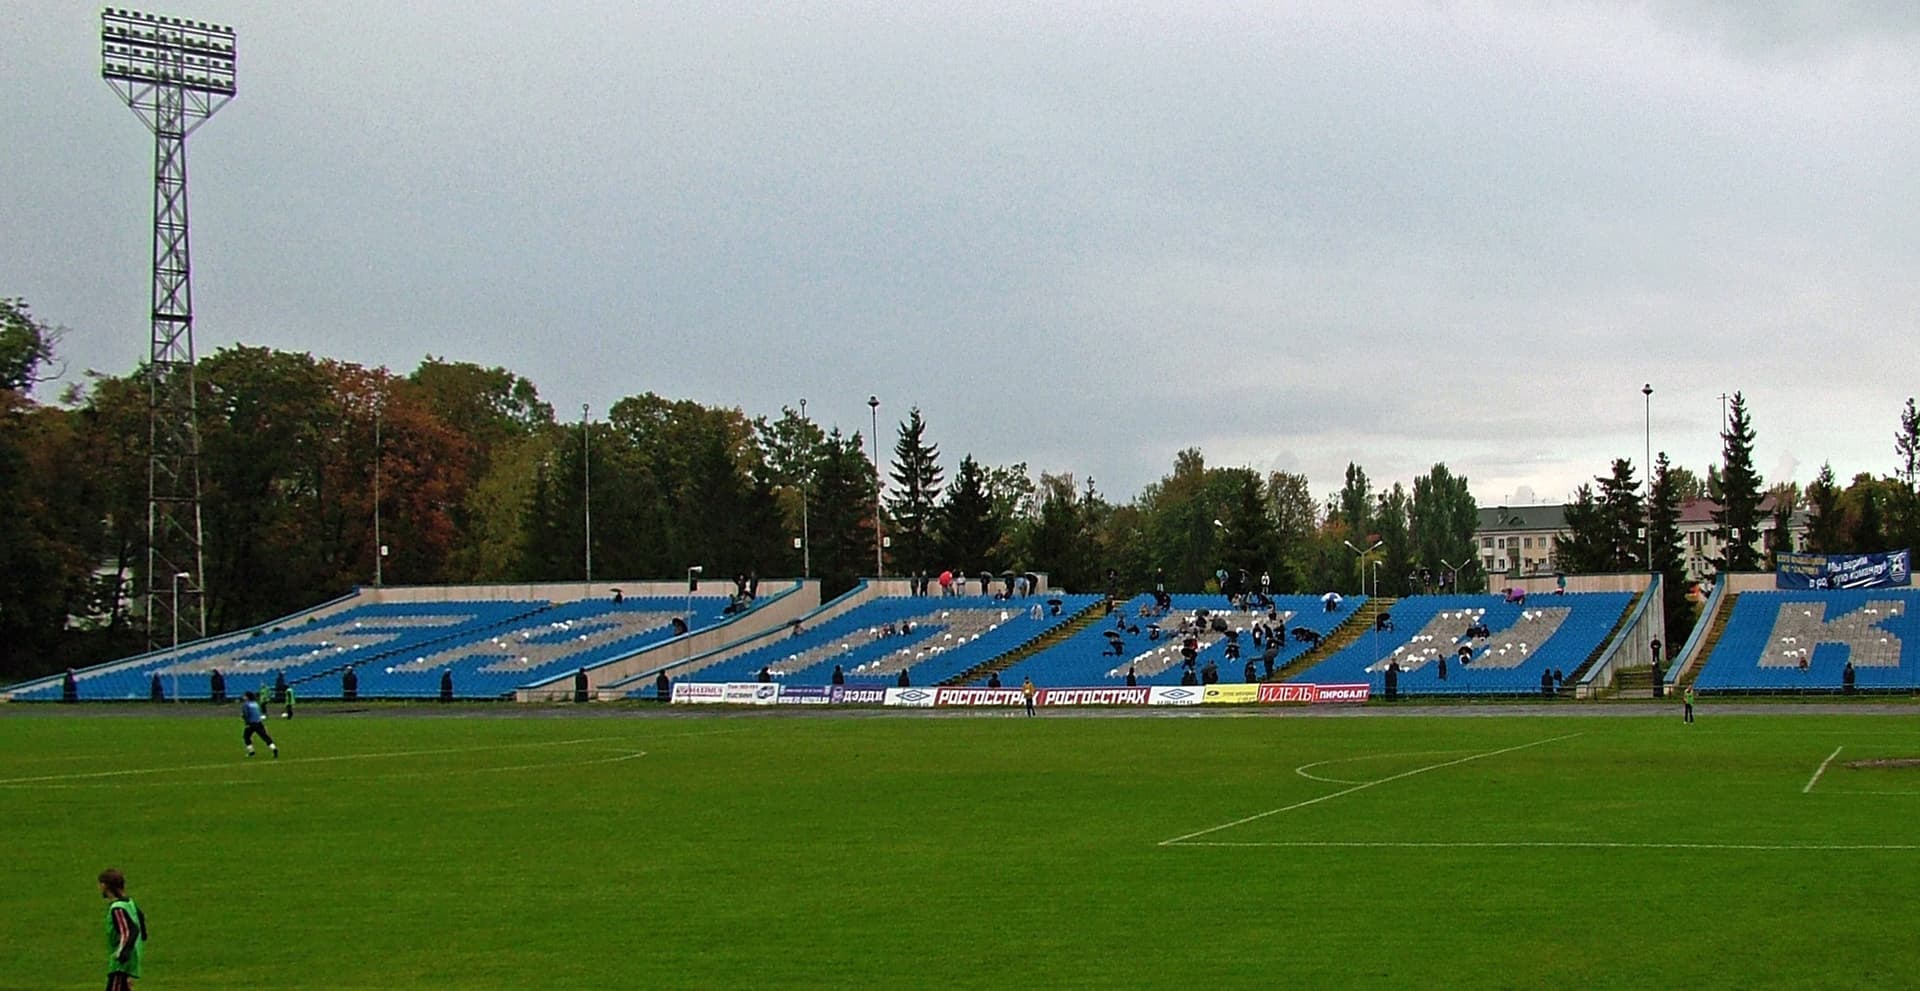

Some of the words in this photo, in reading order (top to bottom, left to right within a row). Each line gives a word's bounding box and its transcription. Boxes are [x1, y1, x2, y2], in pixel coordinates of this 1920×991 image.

[1843, 556, 1868, 570] верим
[843, 690, 884, 702] ДЭДДИ
[1045, 689, 1147, 704] РОСГОССТРАХ
[1261, 687, 1312, 701] ИДЕЛЬ
[1319, 690, 1368, 699] ПИРОБАЛТ
